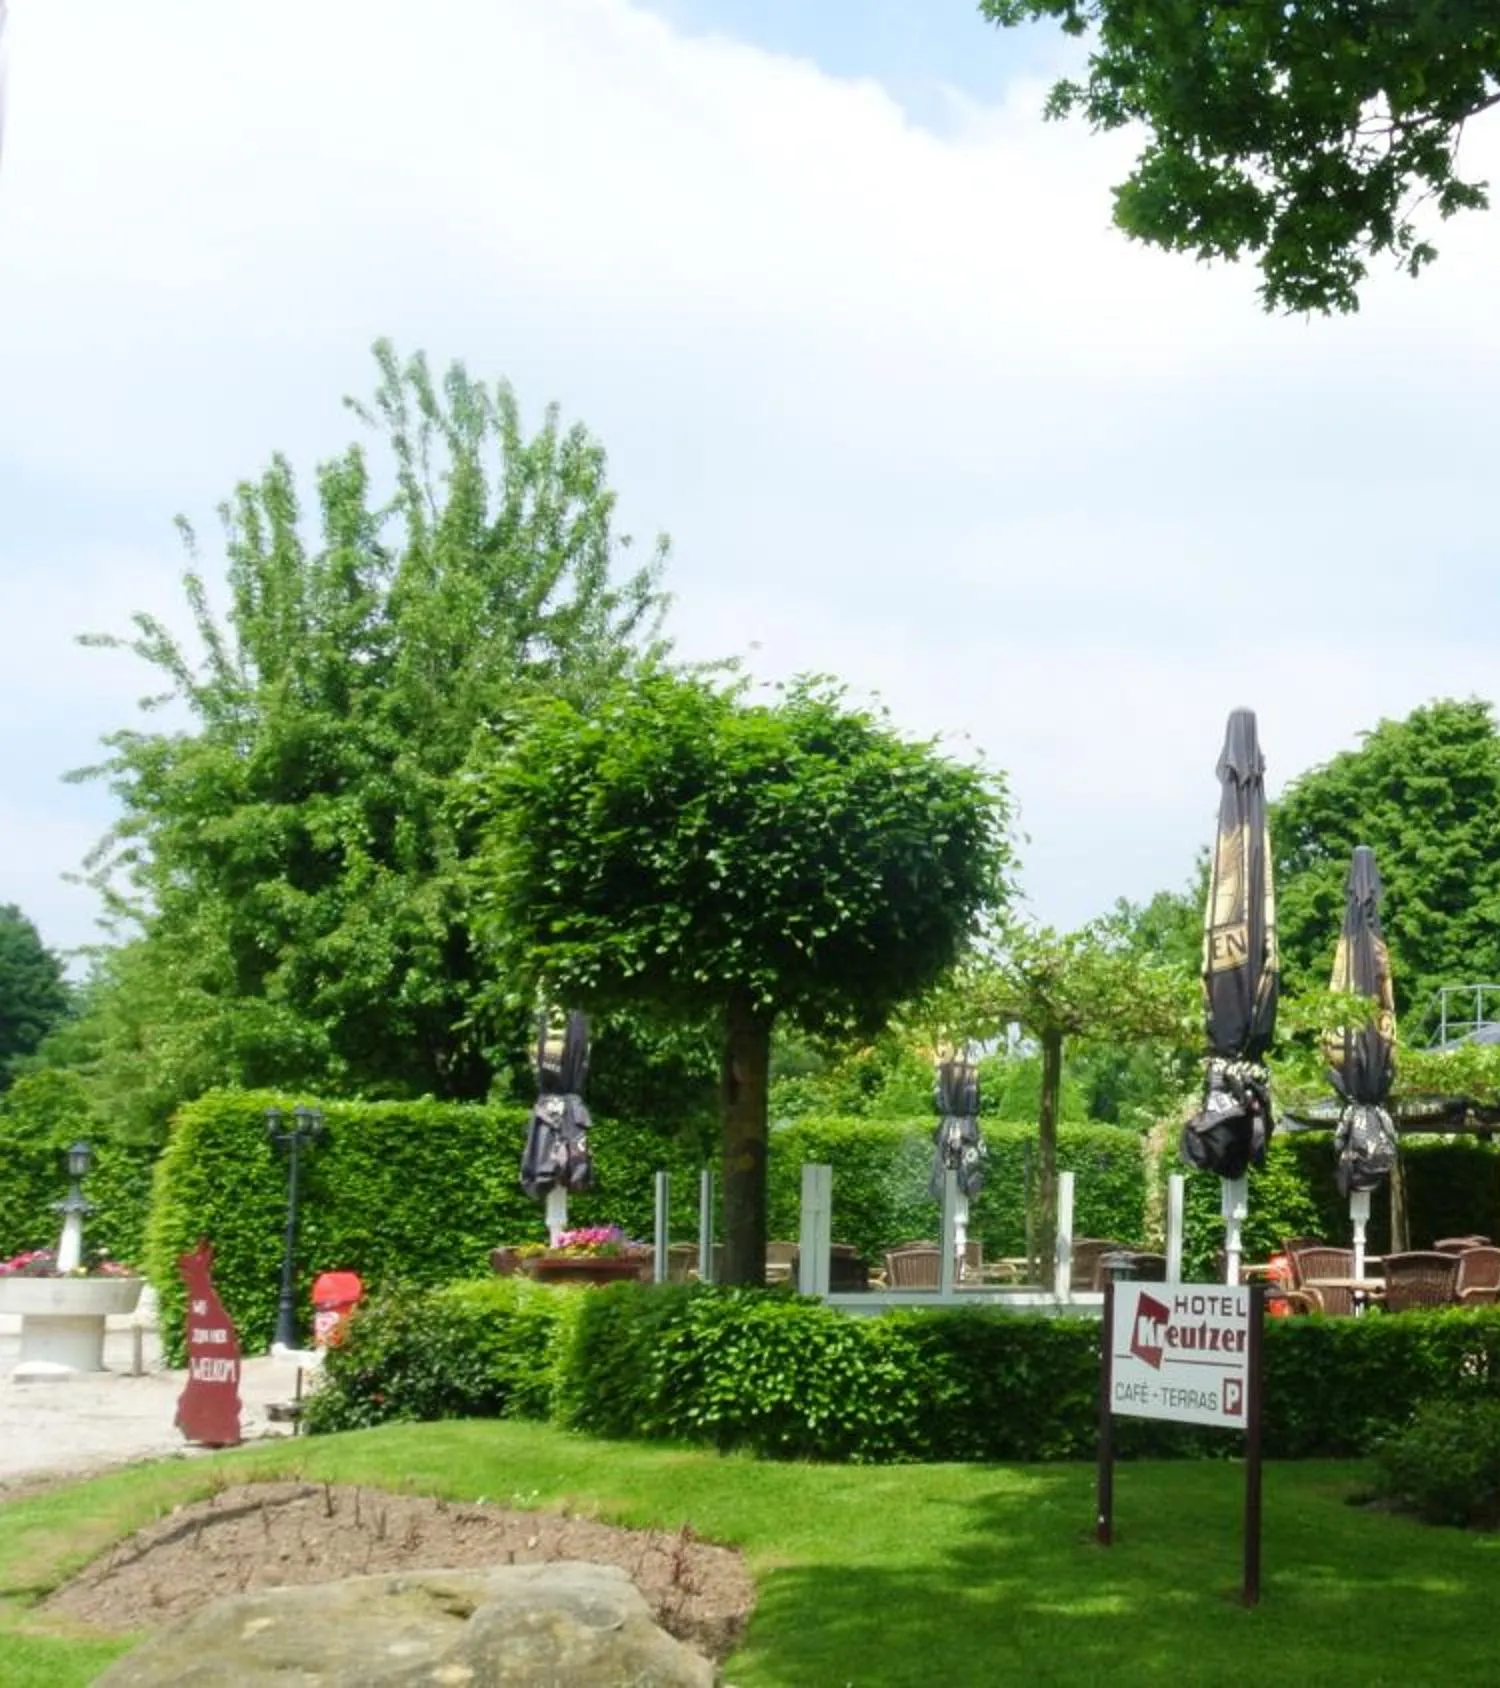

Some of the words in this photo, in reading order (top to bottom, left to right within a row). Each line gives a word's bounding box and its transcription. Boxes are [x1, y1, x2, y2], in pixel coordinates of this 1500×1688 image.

[1174, 1294, 1247, 1318] HOTEL
[1136, 1315, 1247, 1353] Kreutzer
[190, 1356, 237, 1384] WELKOM
[1162, 1386, 1218, 1411] TERRAS
